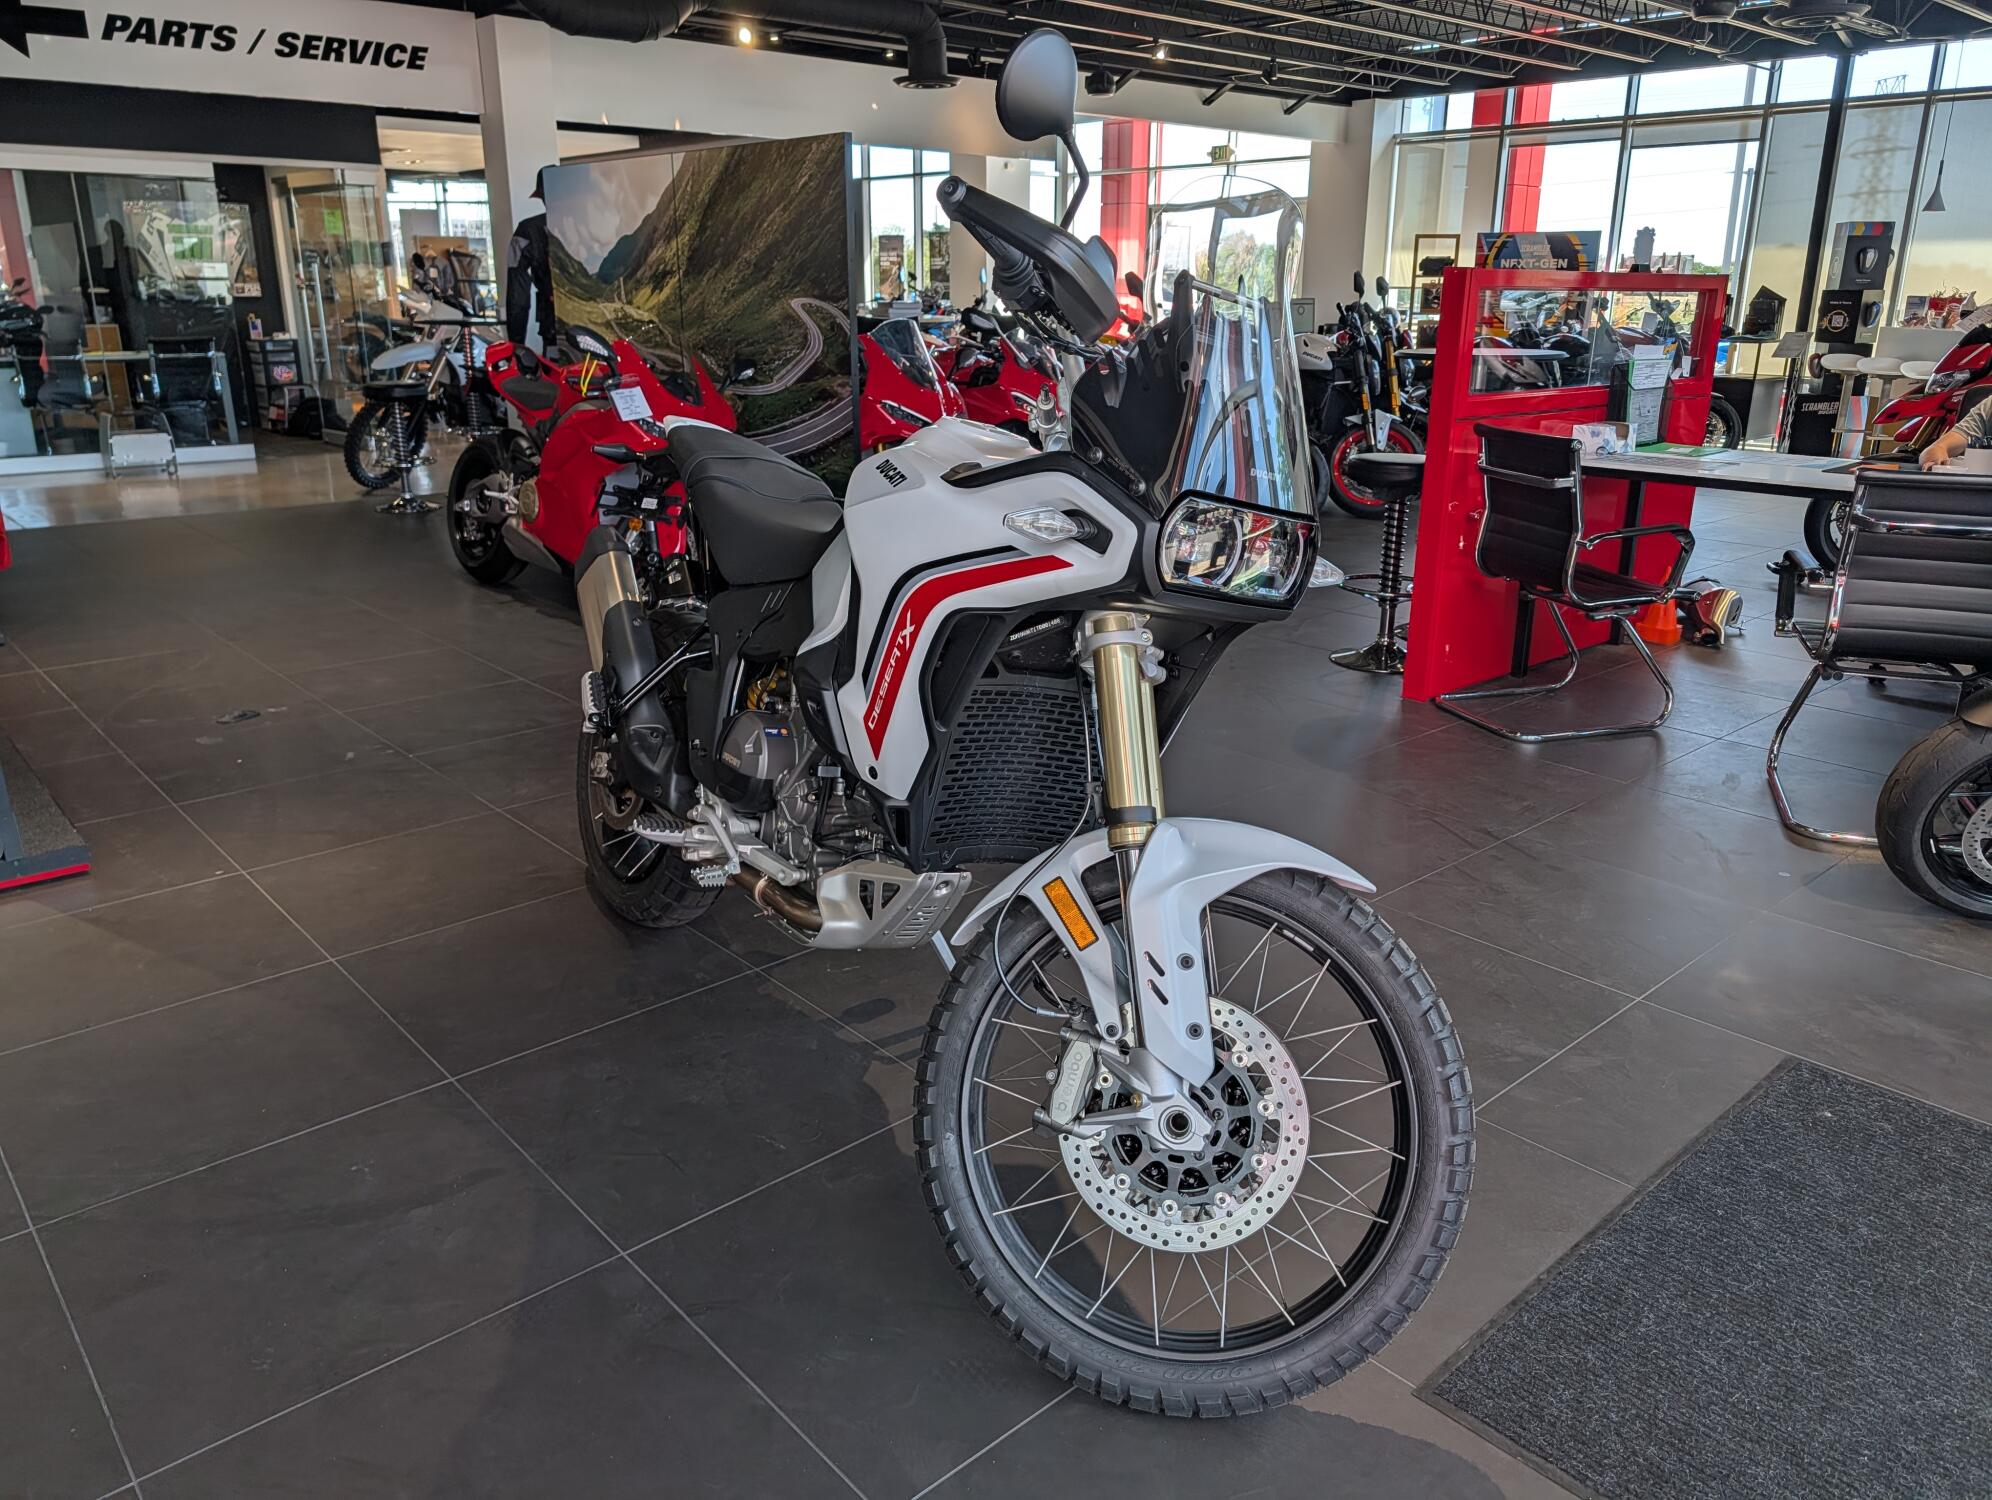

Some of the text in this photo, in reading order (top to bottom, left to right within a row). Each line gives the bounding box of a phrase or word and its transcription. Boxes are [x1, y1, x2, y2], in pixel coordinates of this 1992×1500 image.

[101, 14, 429, 71] PARTS / SERVICE
[1801, 402, 1839, 411] SCRAMBLER
[875, 458, 908, 488] DUCATI
[1250, 468, 1281, 482] DUCA
[1055, 1052, 1083, 1112] brembo
